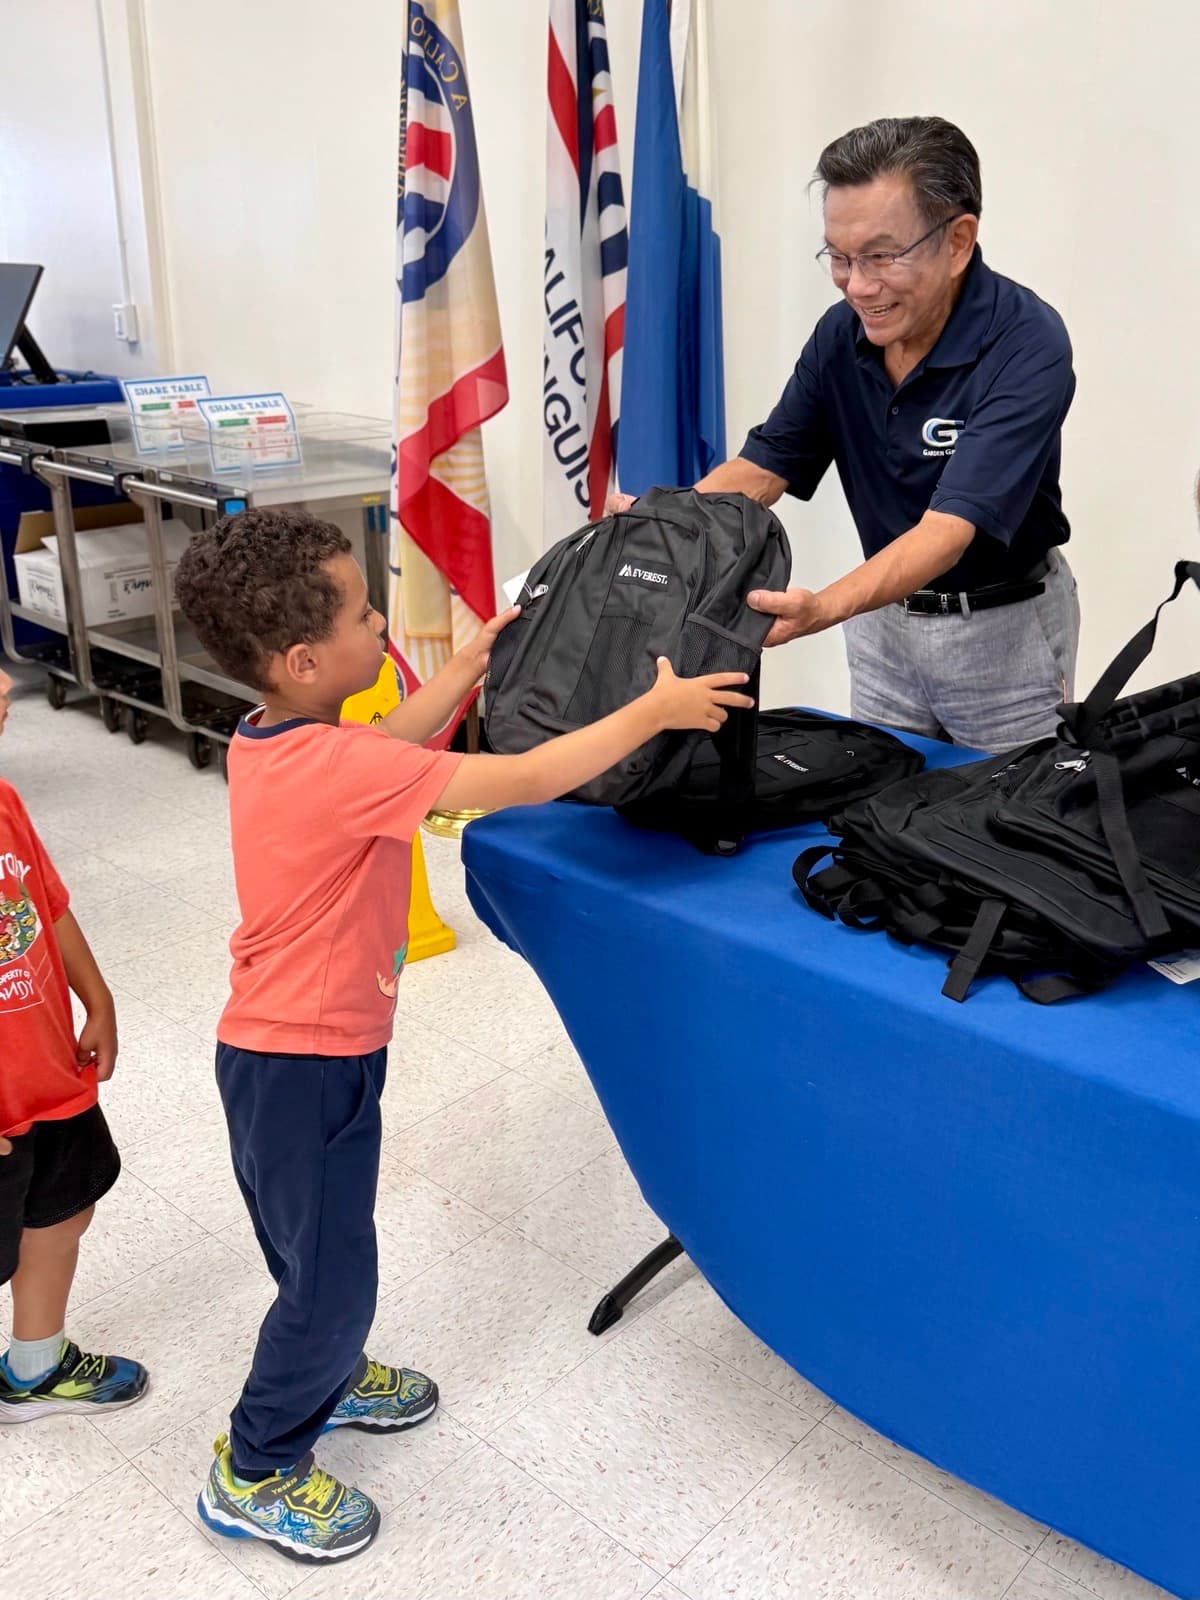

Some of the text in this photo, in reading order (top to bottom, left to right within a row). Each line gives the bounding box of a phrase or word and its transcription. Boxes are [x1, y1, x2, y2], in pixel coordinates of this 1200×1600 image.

[134, 383, 203, 396] SHARE TABLE
[208, 402, 245, 413] SHARE
[246, 399, 282, 410] TABLE
